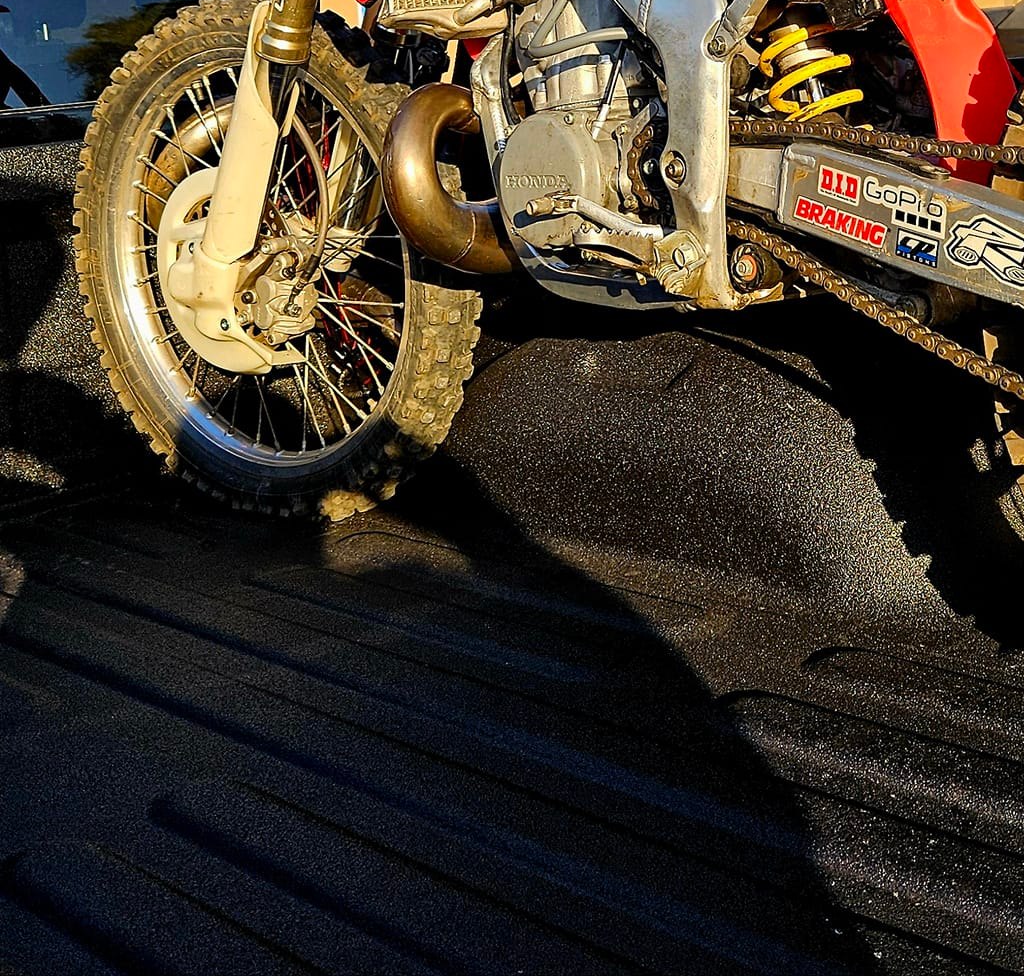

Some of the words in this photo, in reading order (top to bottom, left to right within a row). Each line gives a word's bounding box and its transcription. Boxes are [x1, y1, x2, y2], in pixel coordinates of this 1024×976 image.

[504, 174, 571, 189] HONDA
[821, 168, 858, 199] D.I.D
[795, 198, 886, 246] BRAKING
[897, 250, 936, 267] PISTONS
